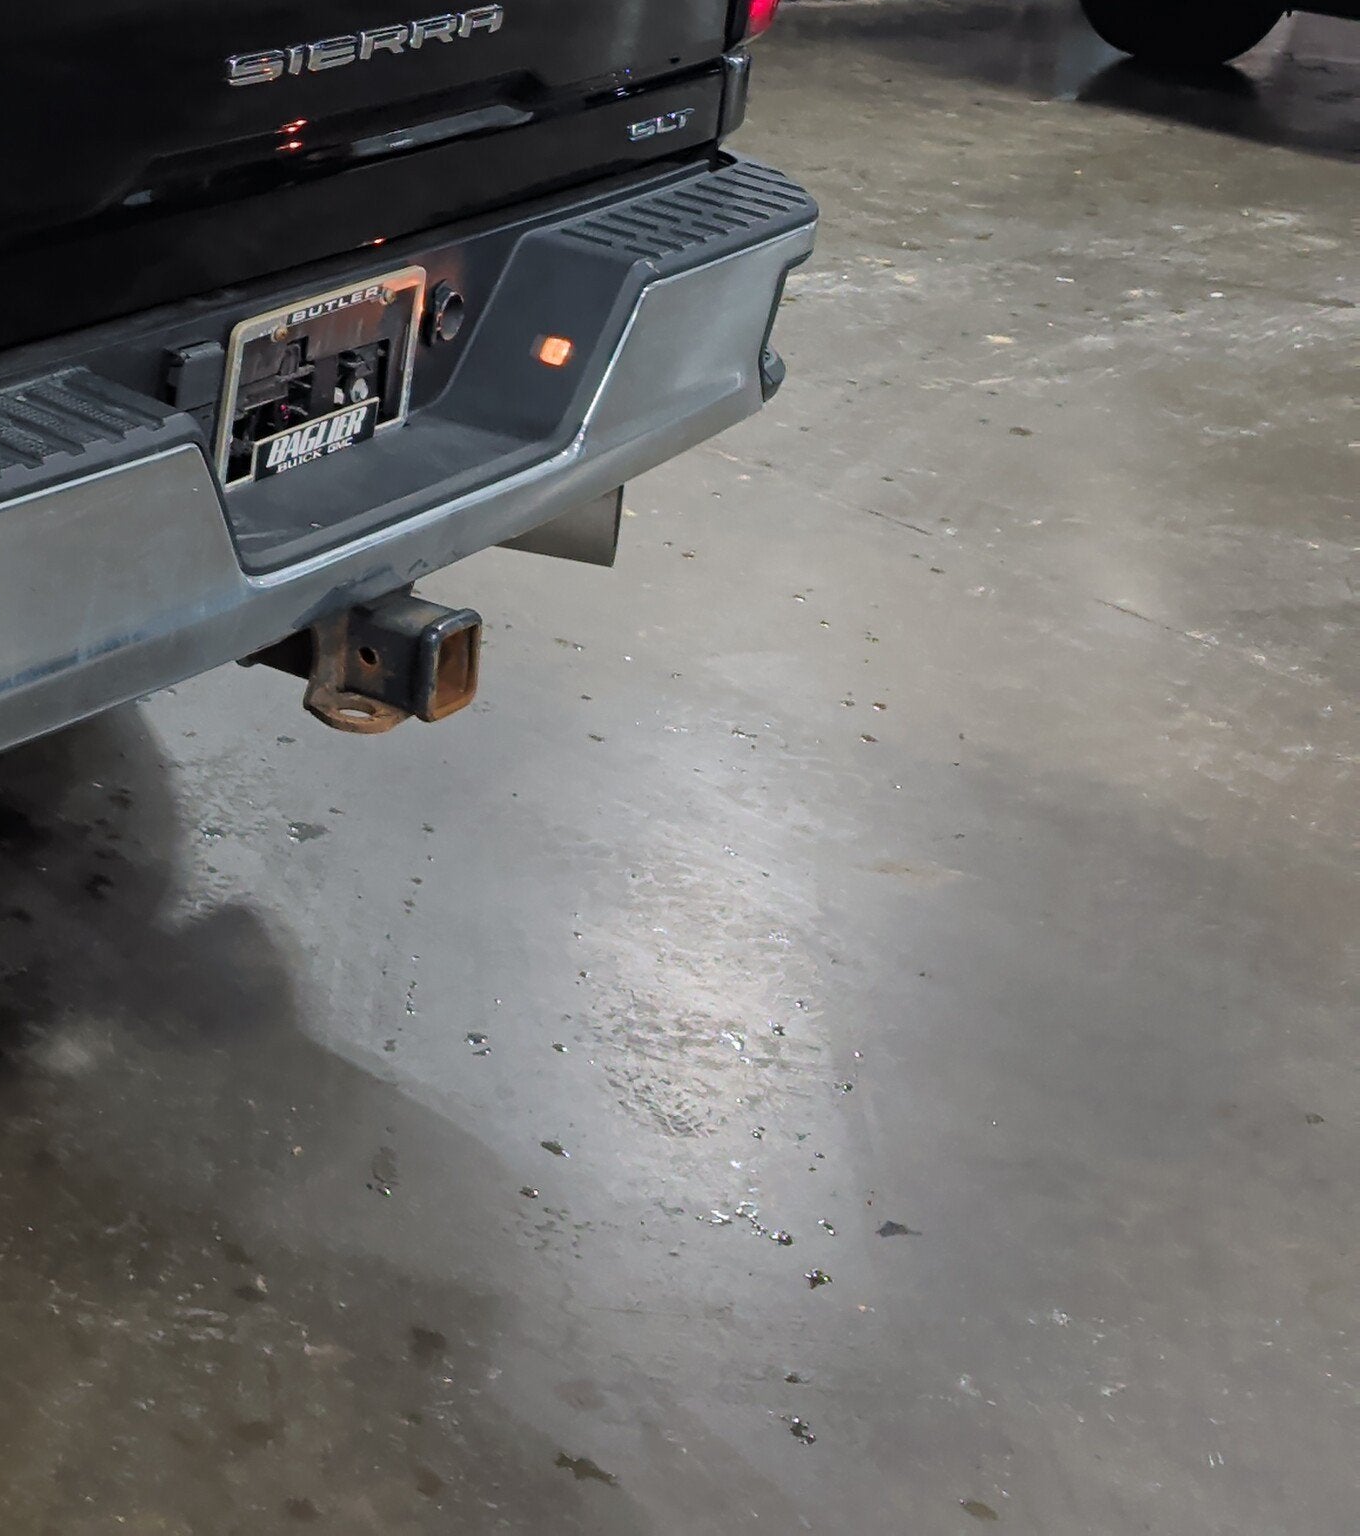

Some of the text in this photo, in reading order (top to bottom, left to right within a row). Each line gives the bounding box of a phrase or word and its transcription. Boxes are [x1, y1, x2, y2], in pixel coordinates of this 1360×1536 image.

[225, 4, 504, 86] SIERRA
[626, 107, 696, 141] SLT
[292, 285, 380, 324] BUTLER
[265, 405, 368, 469] BAGLIER
[276, 436, 355, 474] BUICK GMC
